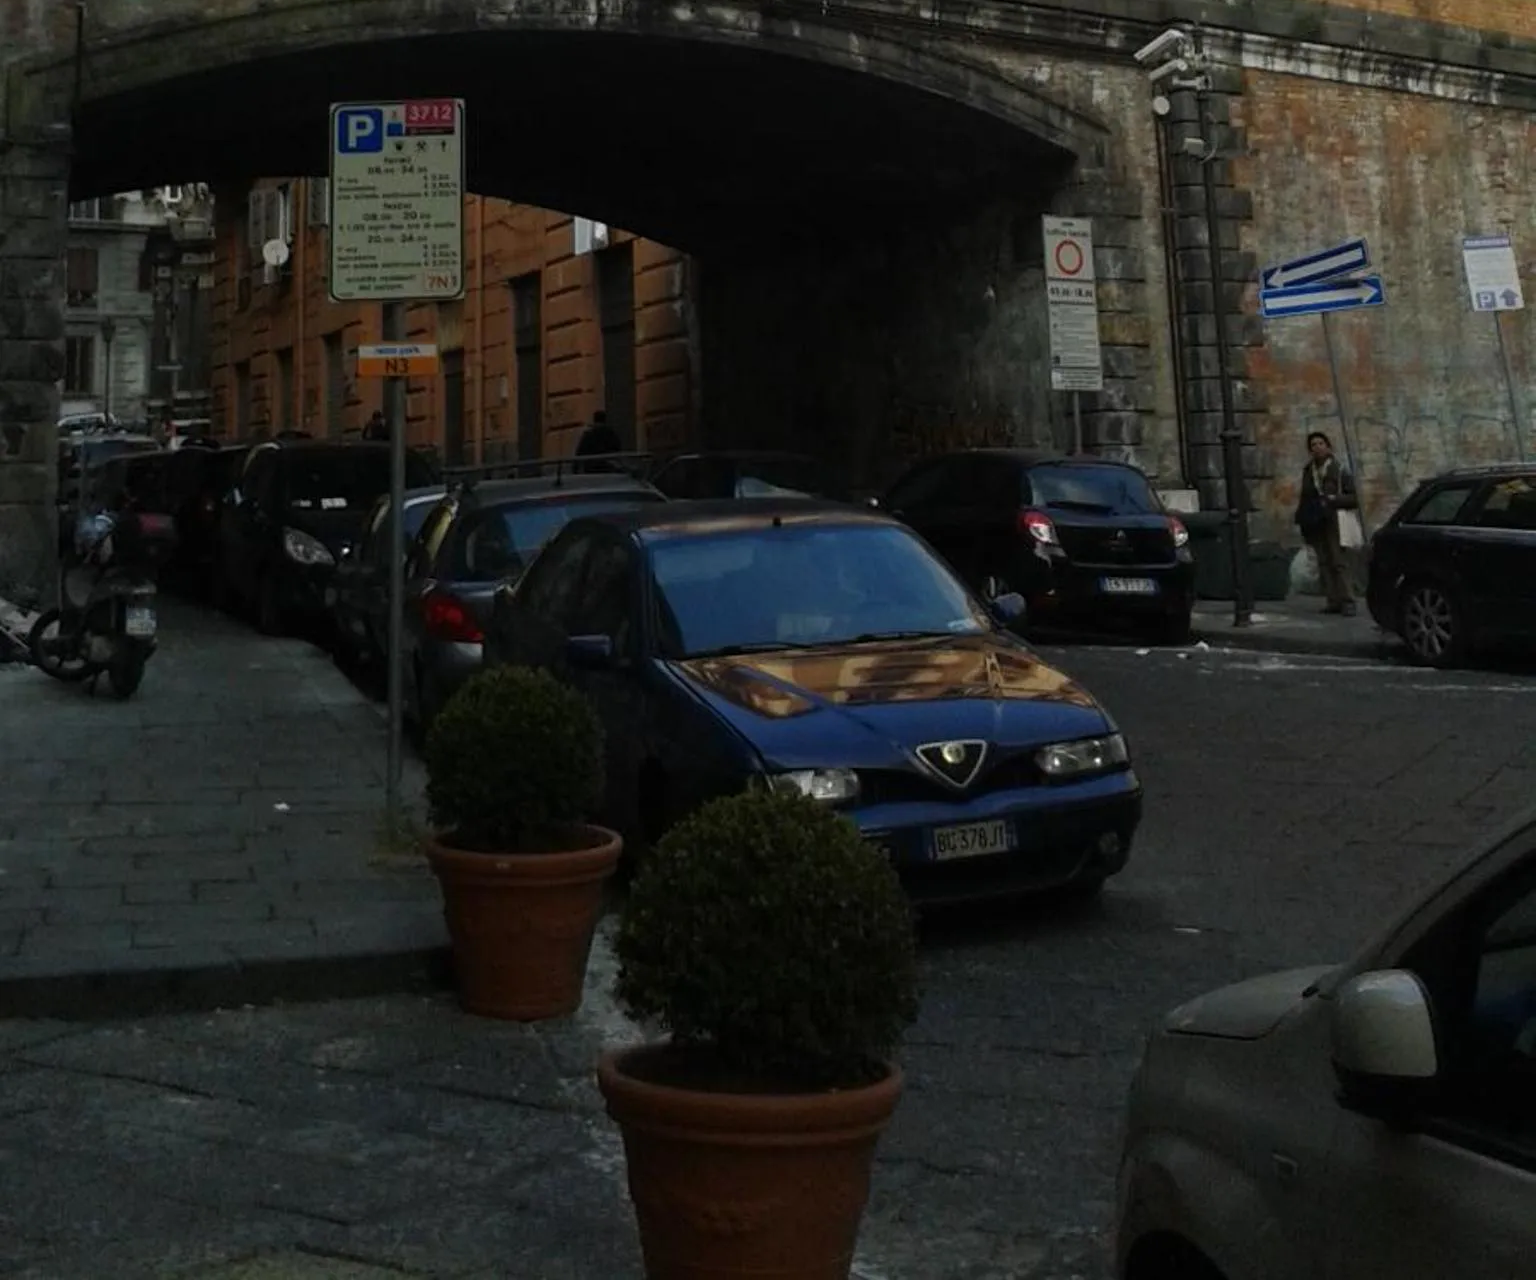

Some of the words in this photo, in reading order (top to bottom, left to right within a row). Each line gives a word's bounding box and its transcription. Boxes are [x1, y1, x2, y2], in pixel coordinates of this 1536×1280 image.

[408, 104, 452, 121] 3712
[348, 115, 375, 148] P
[385, 357, 409, 373] N3
